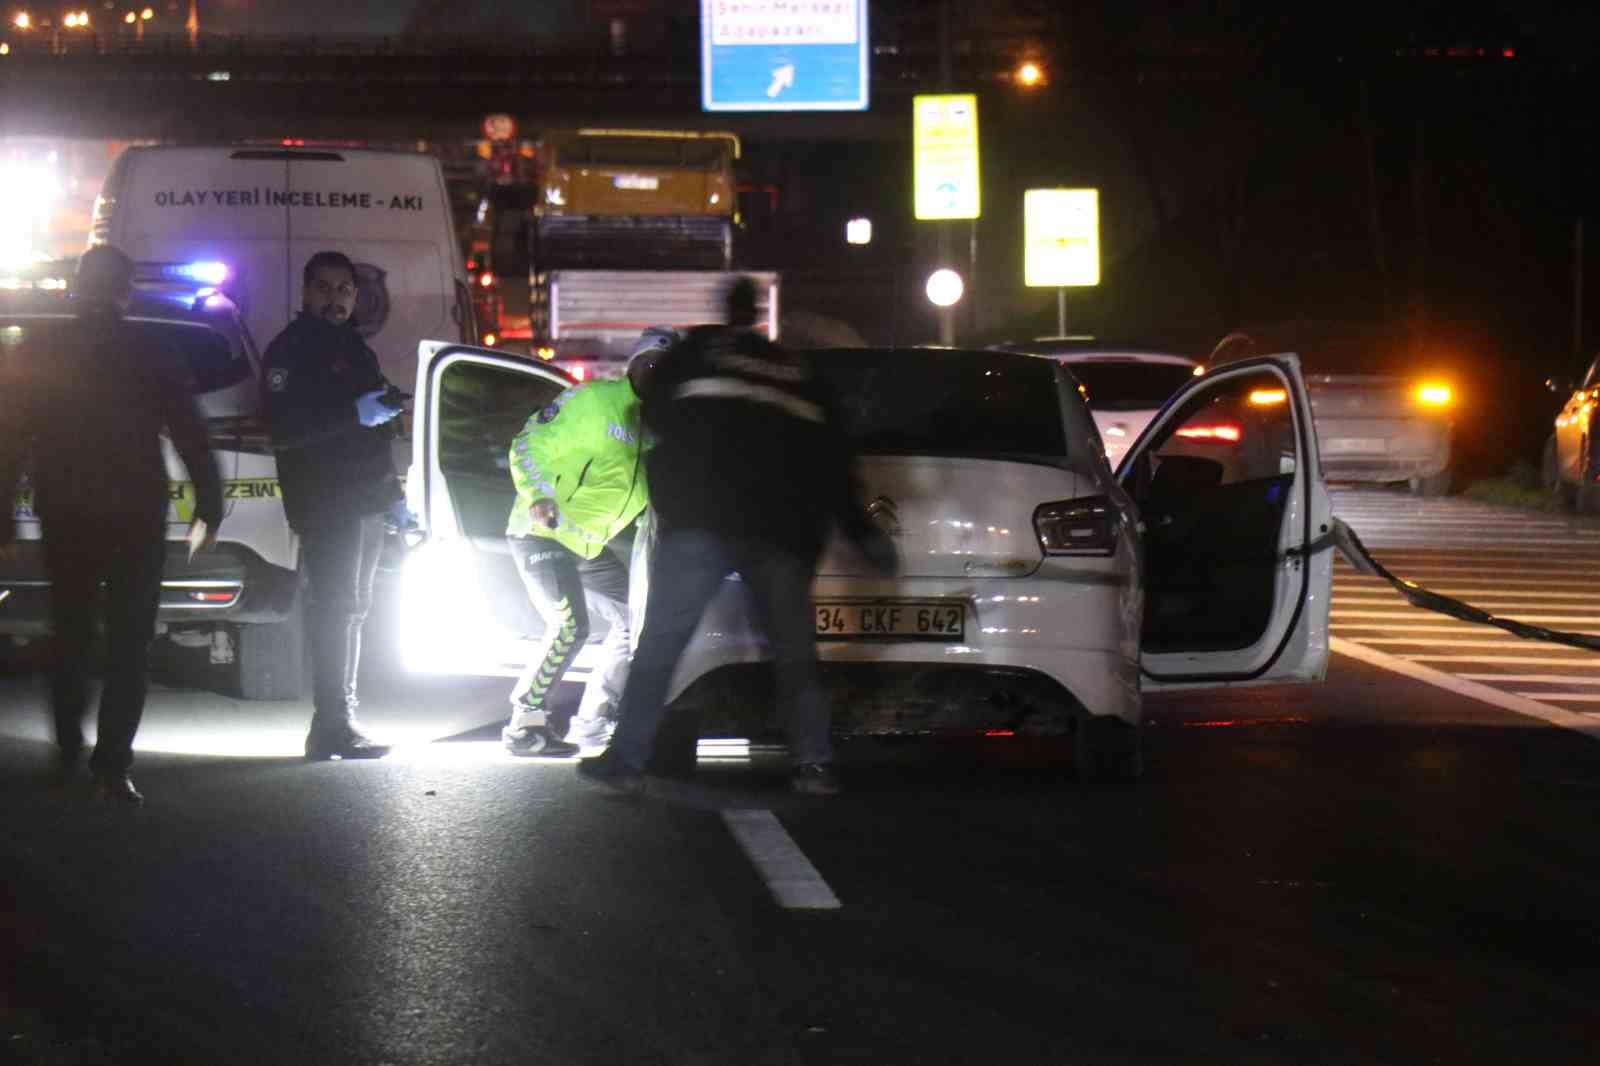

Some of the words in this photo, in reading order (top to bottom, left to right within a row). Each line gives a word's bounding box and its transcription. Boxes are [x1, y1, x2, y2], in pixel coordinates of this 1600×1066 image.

[154, 190, 207, 206] OLAY
[212, 188, 259, 207] YERİ
[265, 188, 371, 208] İNCELEME
[389, 195, 423, 211] AKI
[817, 608, 845, 633] 34
[860, 608, 900, 633] CKF
[916, 608, 960, 633] 642
